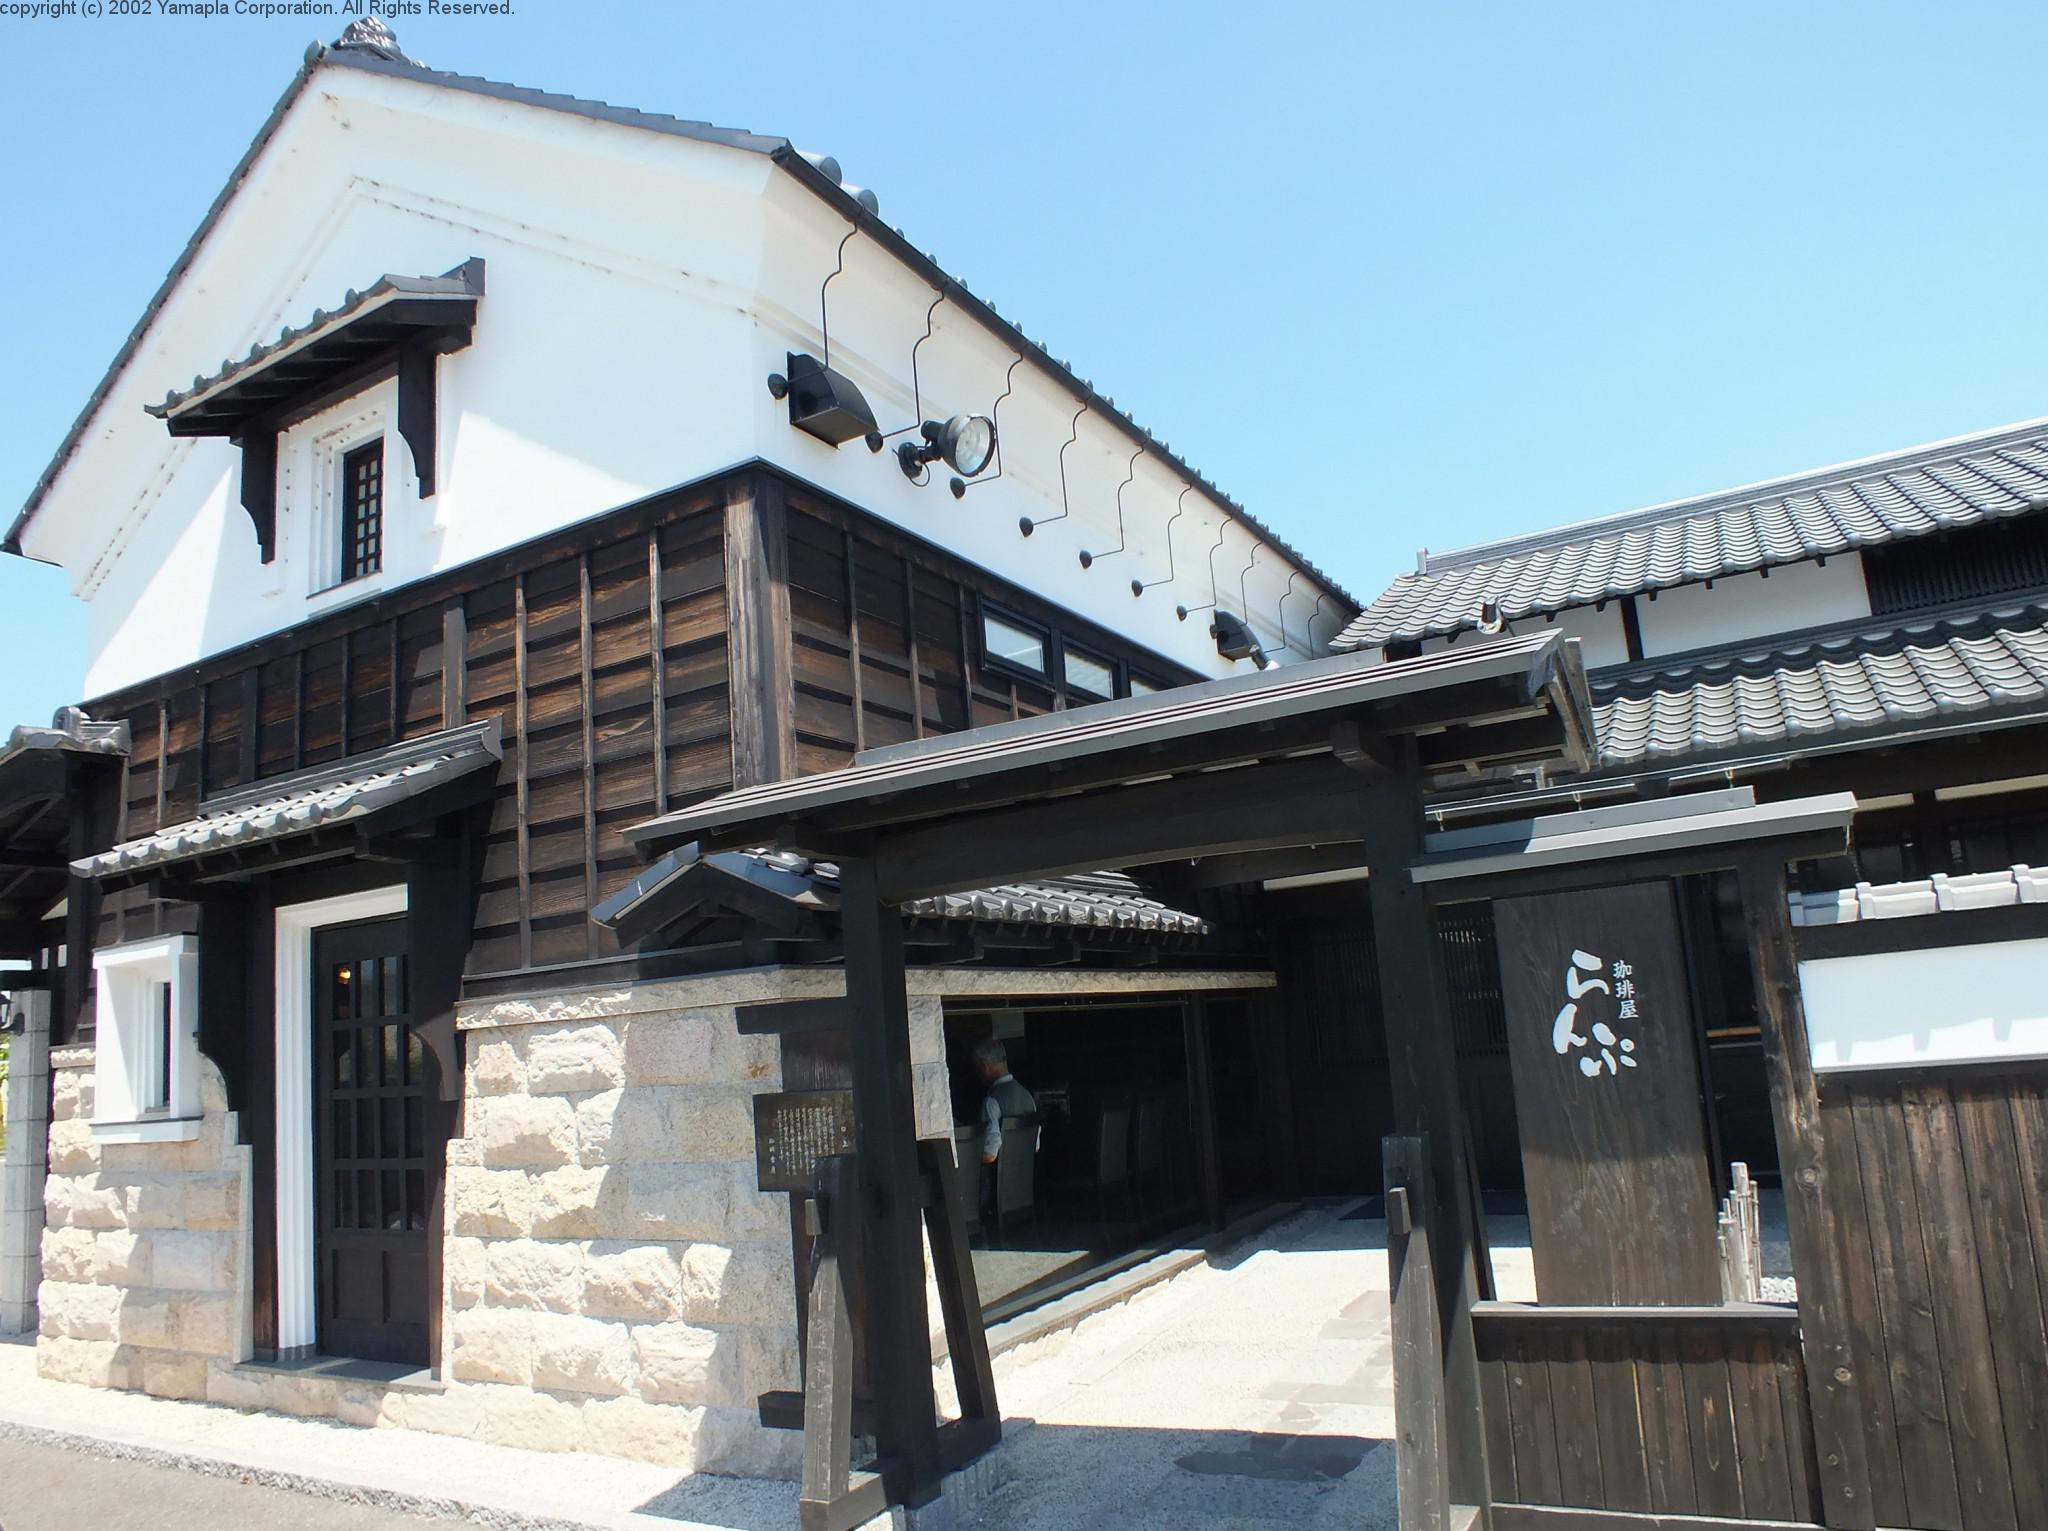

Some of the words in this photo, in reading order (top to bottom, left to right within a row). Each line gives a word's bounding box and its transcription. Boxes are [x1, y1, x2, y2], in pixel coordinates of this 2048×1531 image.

[1552, 949, 1638, 1078] らんぷ
[1612, 959, 1640, 1020] 珈琲屋
